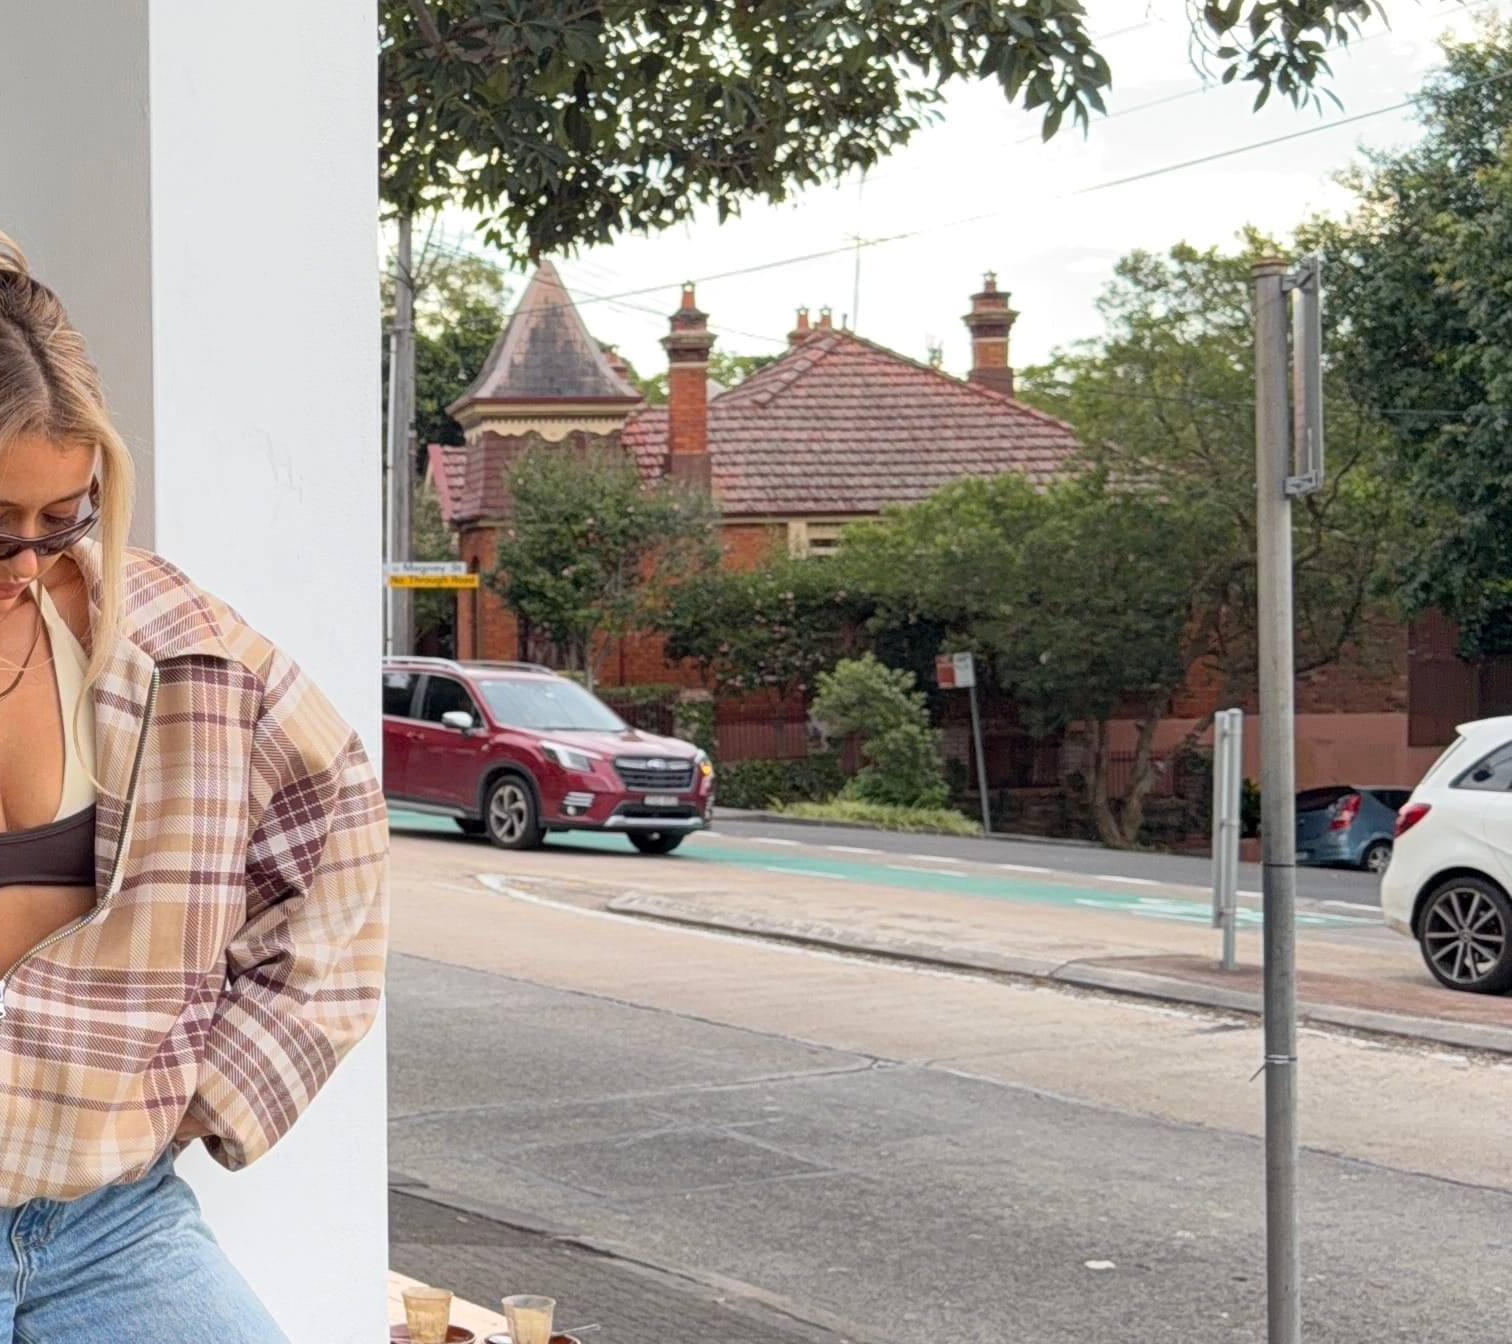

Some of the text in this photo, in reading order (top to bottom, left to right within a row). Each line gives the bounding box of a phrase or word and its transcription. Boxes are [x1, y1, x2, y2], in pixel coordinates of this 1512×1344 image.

[452, 562, 462, 571] St
[390, 575, 475, 586] No Through Road
